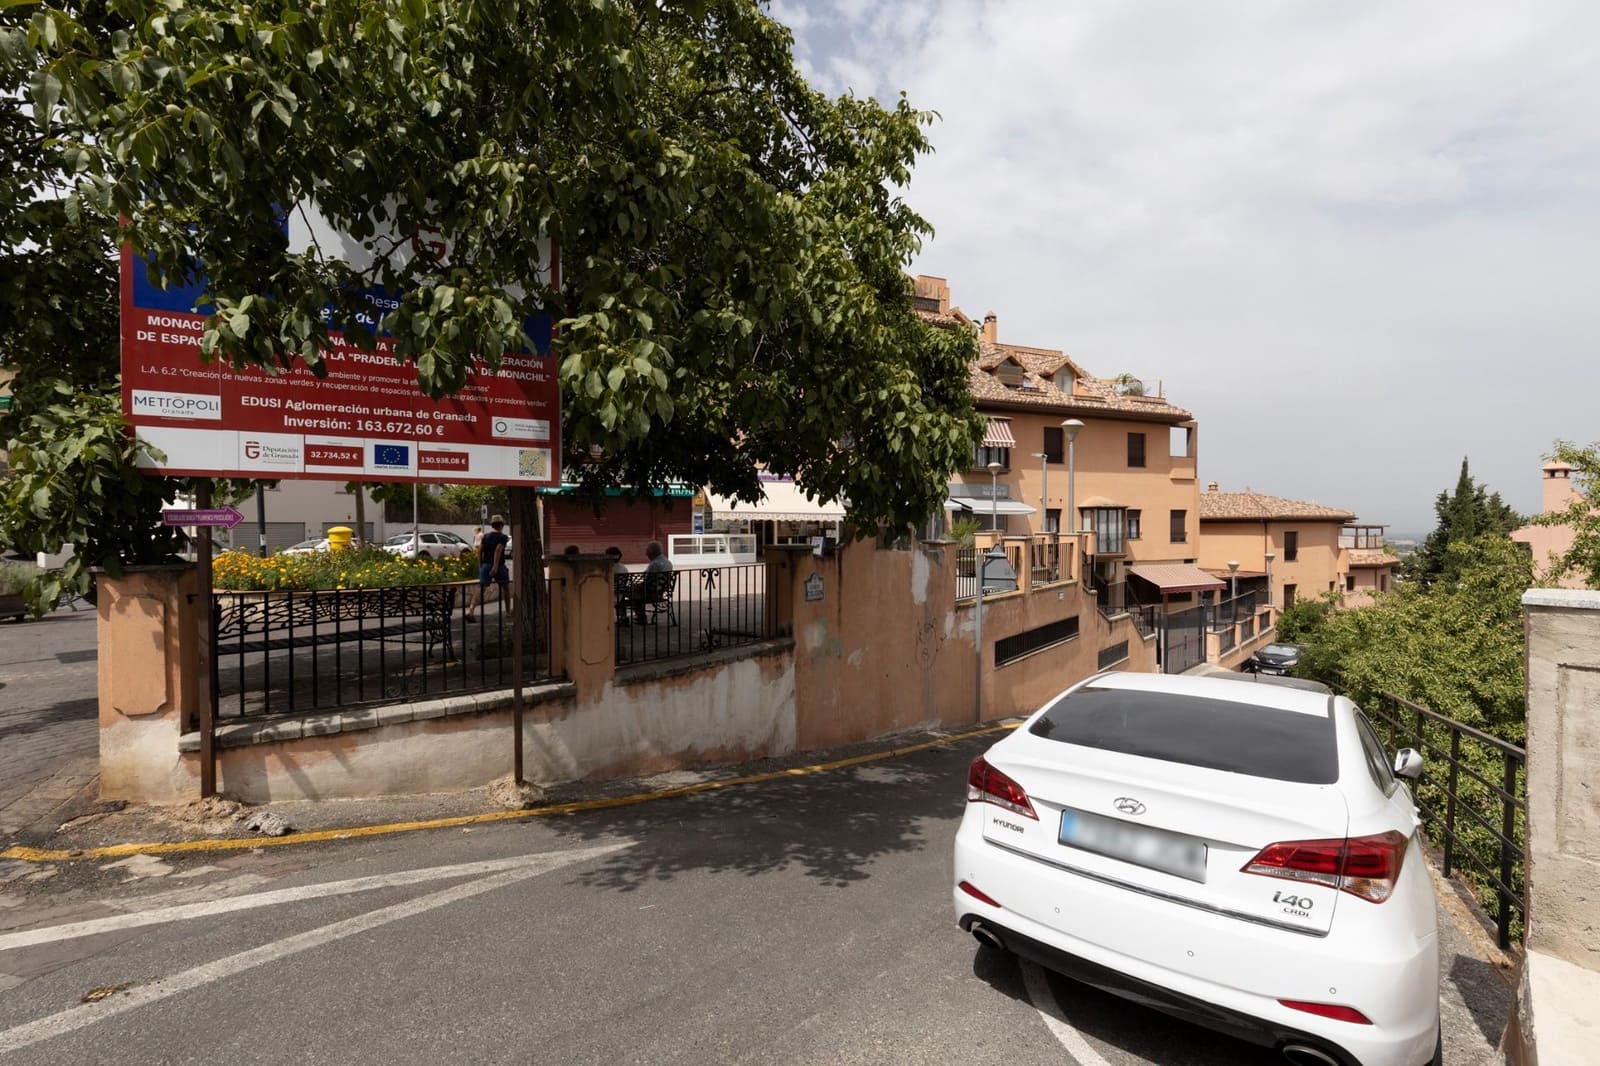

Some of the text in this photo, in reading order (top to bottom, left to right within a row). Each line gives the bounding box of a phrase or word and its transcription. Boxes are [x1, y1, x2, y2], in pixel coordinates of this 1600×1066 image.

[136, 330, 157, 342] DE
[141, 365, 158, 374] L.A.
[161, 367, 177, 376] 6.2
[221, 372, 232, 380] de
[234, 374, 263, 383] nuevas
[264, 377, 287, 385] zonas
[289, 378, 314, 387] verdes
[322, 381, 368, 393] recuperación
[369, 384, 380, 393] de
[381, 386, 411, 397] espacios
[328, 371, 361, 381] ambiente
[368, 375, 401, 385] promover
[402, 377, 409, 385] la
[241, 396, 478, 423] EDUSI Aglomeración urbana de Granada
[283, 415, 445, 436] Inversión: 163.672,60 €
[310, 450, 358, 460] 32.734,52 €
[421, 456, 466, 465] 130.938,08 €
[1272, 890, 1314, 910] i40
